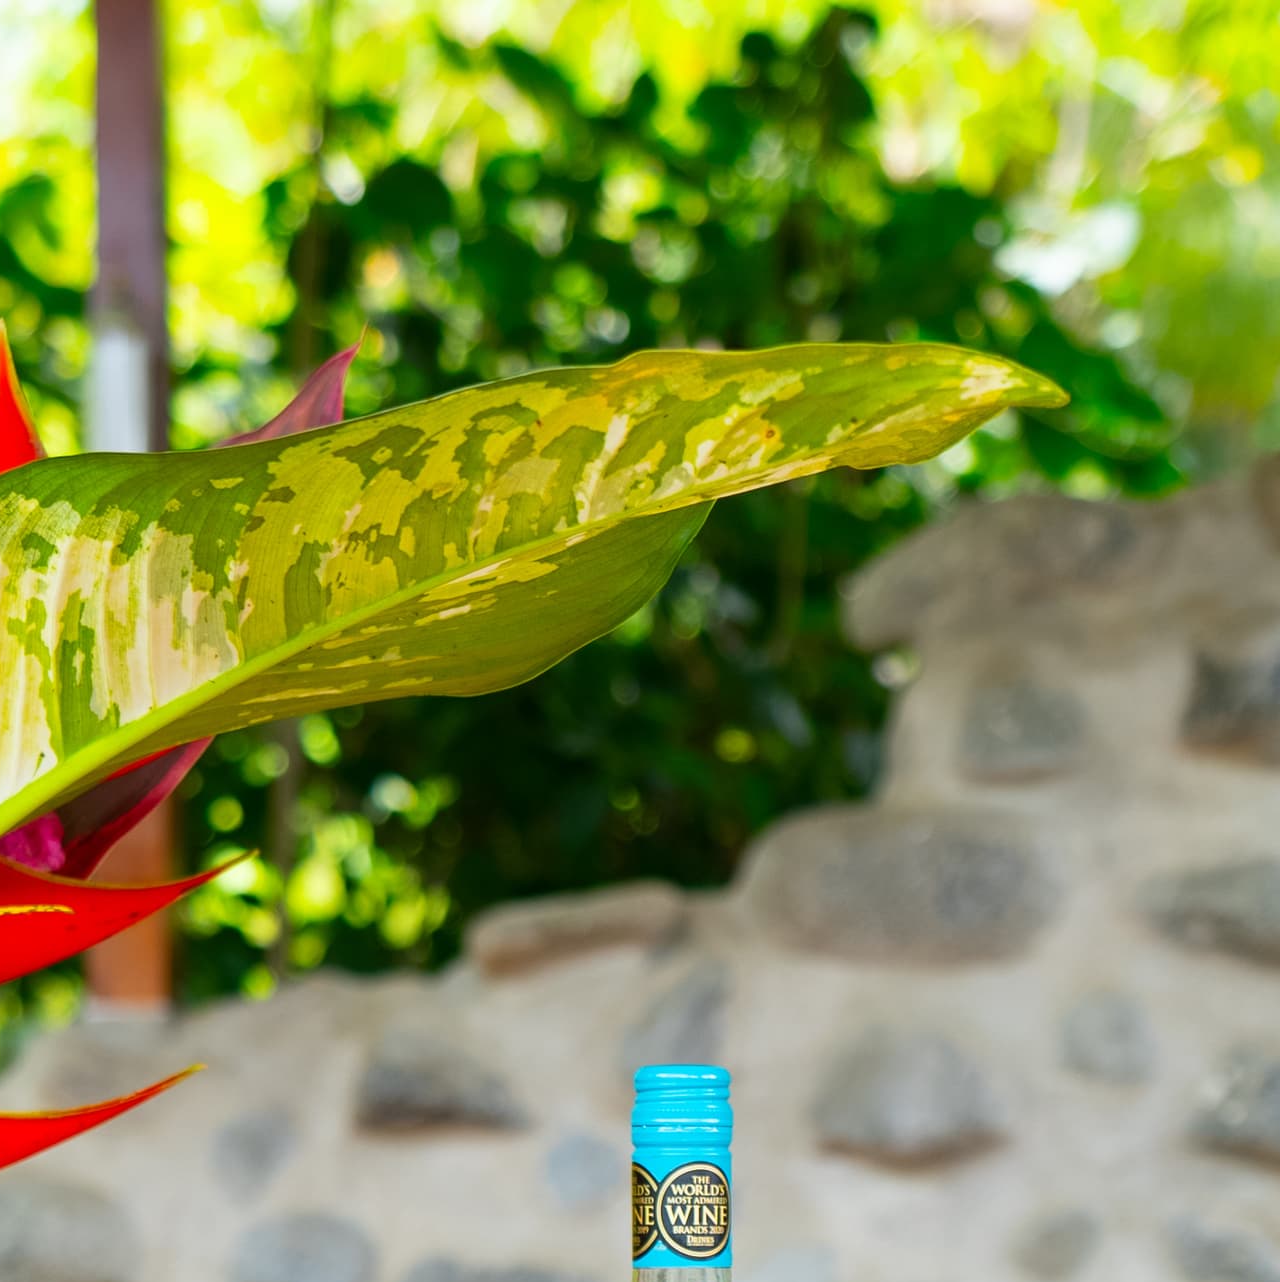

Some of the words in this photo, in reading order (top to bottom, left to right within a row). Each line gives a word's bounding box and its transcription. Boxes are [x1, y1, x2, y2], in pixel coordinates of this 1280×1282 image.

[692, 1176, 711, 1184] THE
[670, 1184, 725, 1195] WORLD'S
[665, 1205, 727, 1225] WINE
[673, 1226, 707, 1234] BRANDS
